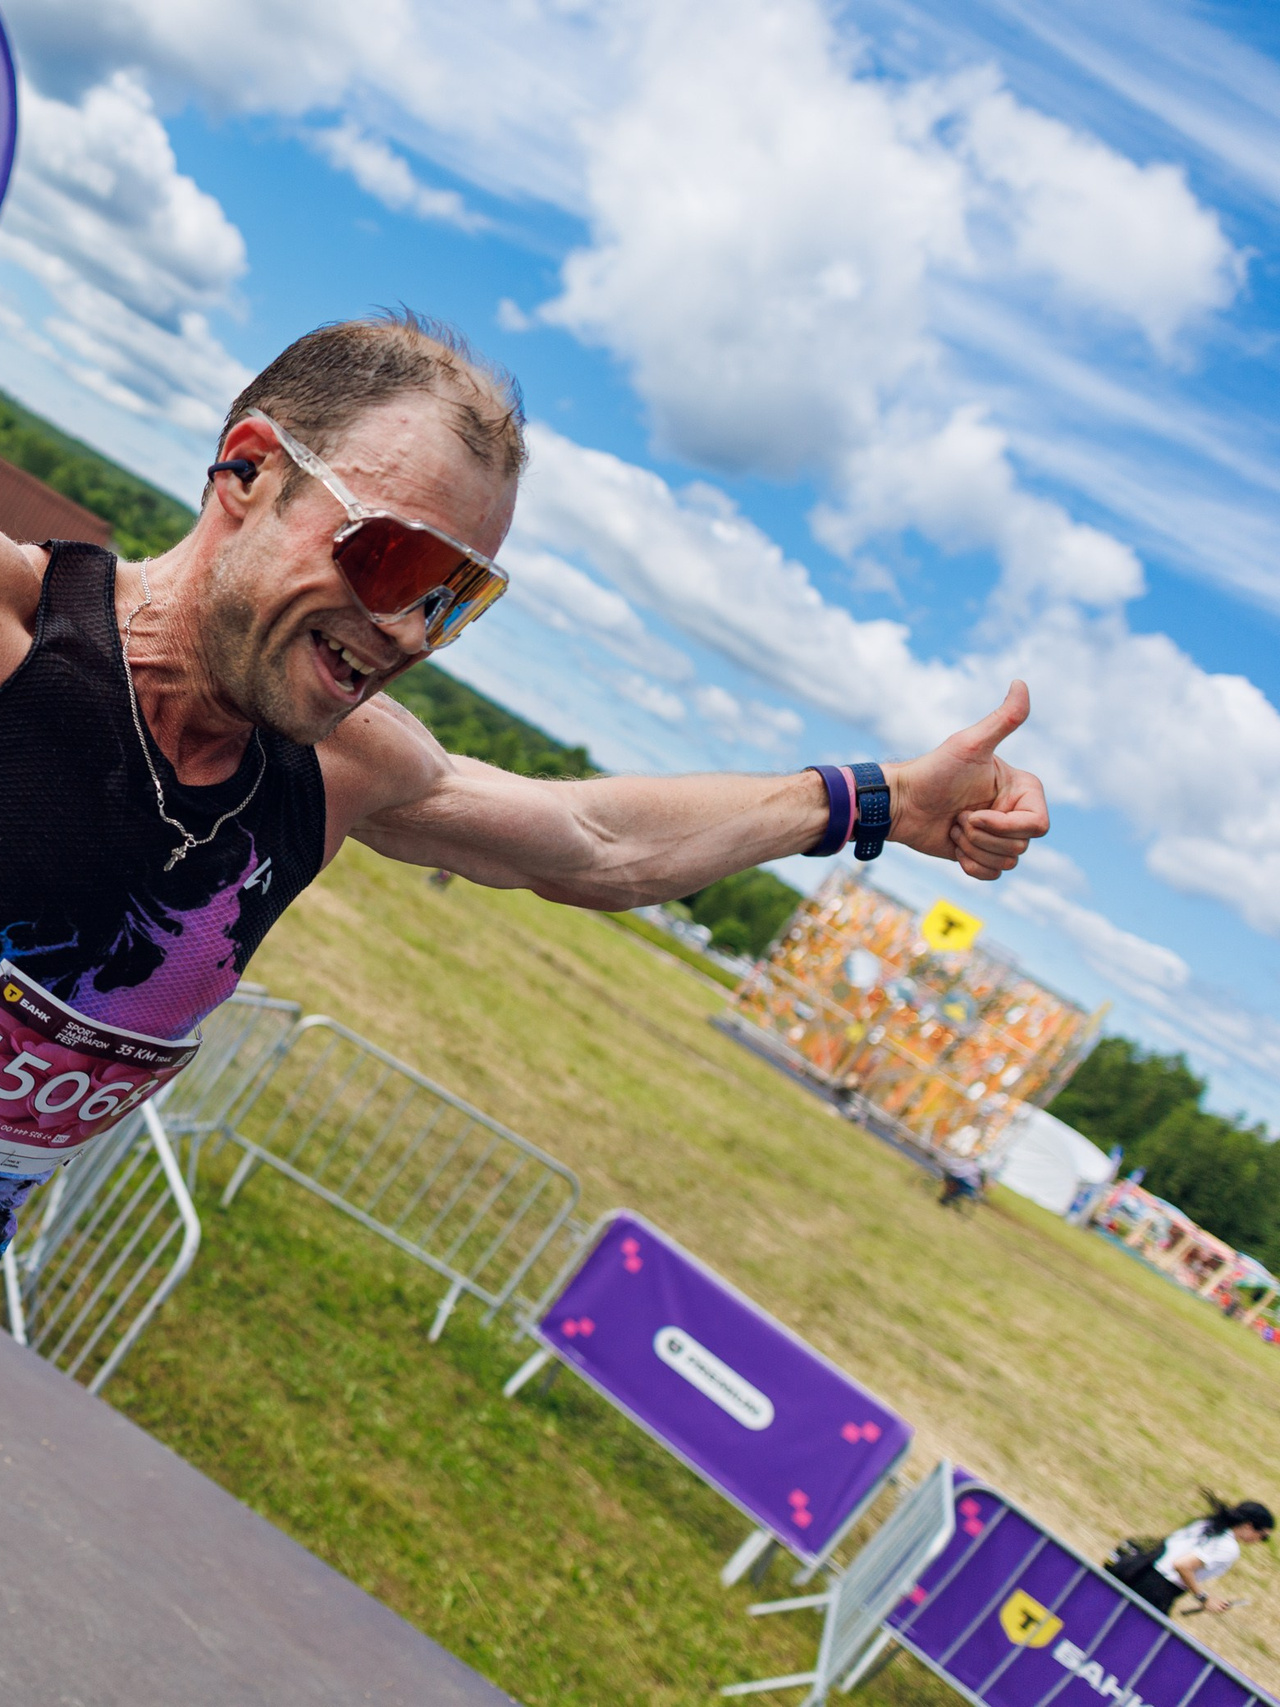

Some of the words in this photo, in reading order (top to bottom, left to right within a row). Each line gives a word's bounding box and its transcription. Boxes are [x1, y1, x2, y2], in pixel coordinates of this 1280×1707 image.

[20, 998, 51, 1024] БАНК
[66, 1021, 97, 1038] SPORT
[55, 1033, 79, 1047] FEST
[115, 1043, 135, 1056] 35
[133, 1048, 158, 1062] KM
